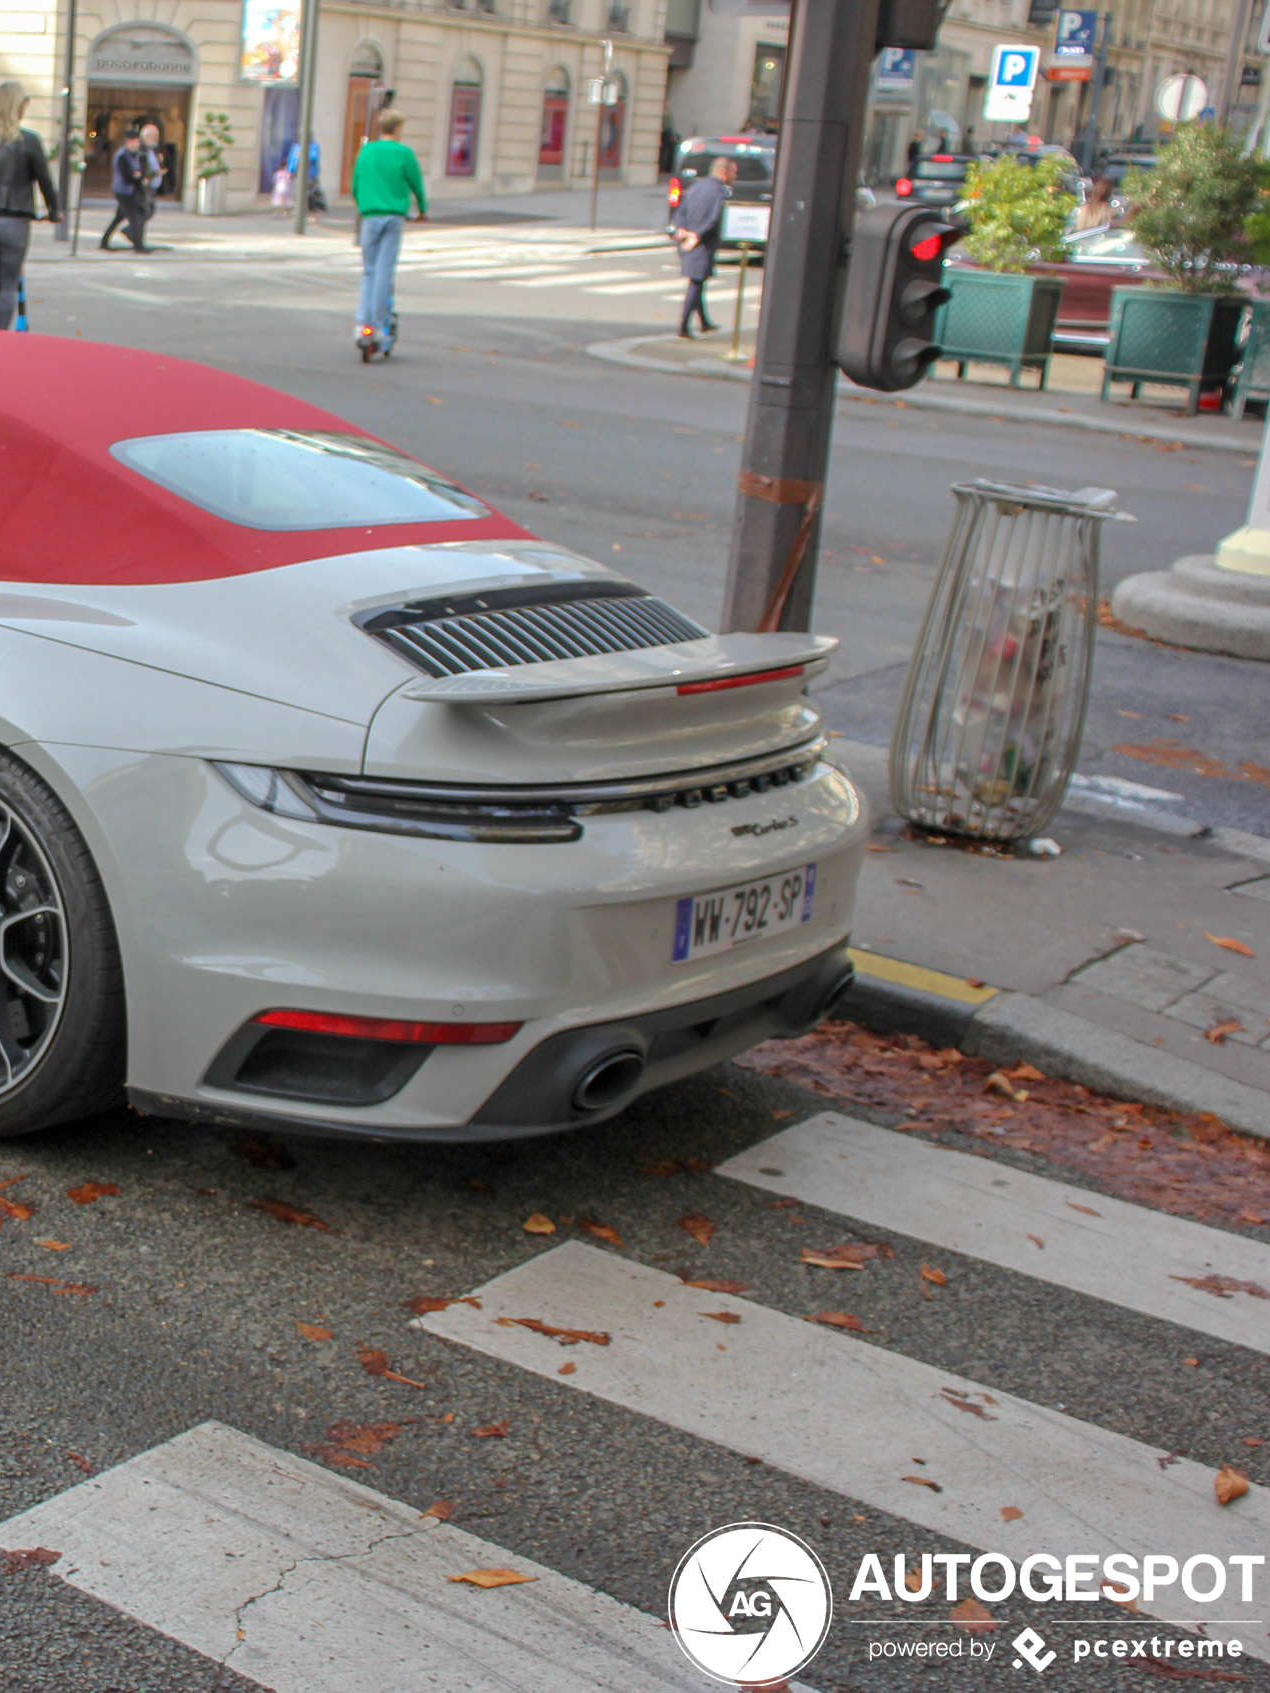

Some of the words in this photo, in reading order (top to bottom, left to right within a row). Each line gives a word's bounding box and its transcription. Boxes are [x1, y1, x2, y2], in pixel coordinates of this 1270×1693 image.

[1057, 11, 1082, 39] P
[96, 59, 130, 71] paco
[1001, 54, 1027, 82] P
